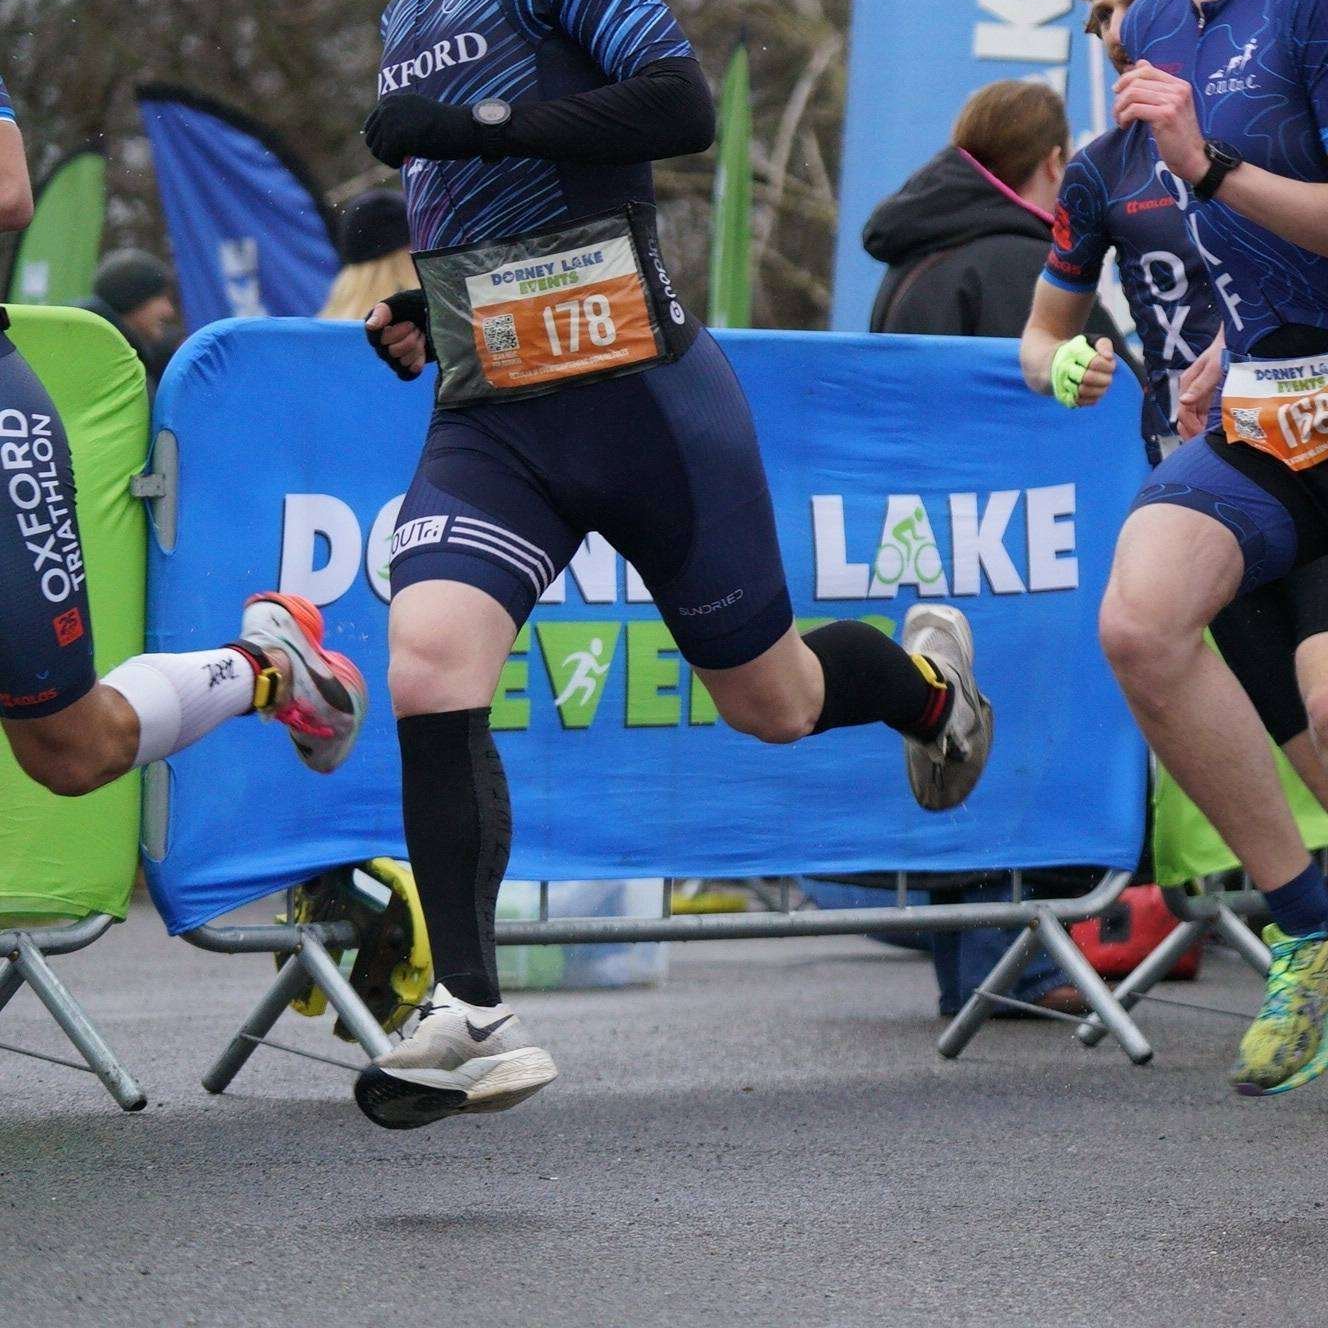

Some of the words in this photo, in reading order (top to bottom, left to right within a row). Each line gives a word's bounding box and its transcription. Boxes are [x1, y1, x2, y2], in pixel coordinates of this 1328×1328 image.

[377, 32, 488, 99] XFORD
[490, 261, 555, 286] DORNEY
[561, 249, 605, 271] LAKE
[519, 271, 580, 295] EVENTS
[542, 293, 617, 358] 178
[1254, 365, 1305, 381] DORNEY
[0, 408, 70, 603] OXFORD
[31, 413, 85, 592] TRIATHLON
[812, 483, 1079, 600] LAKE
[679, 588, 744, 616] SUNDRIED
